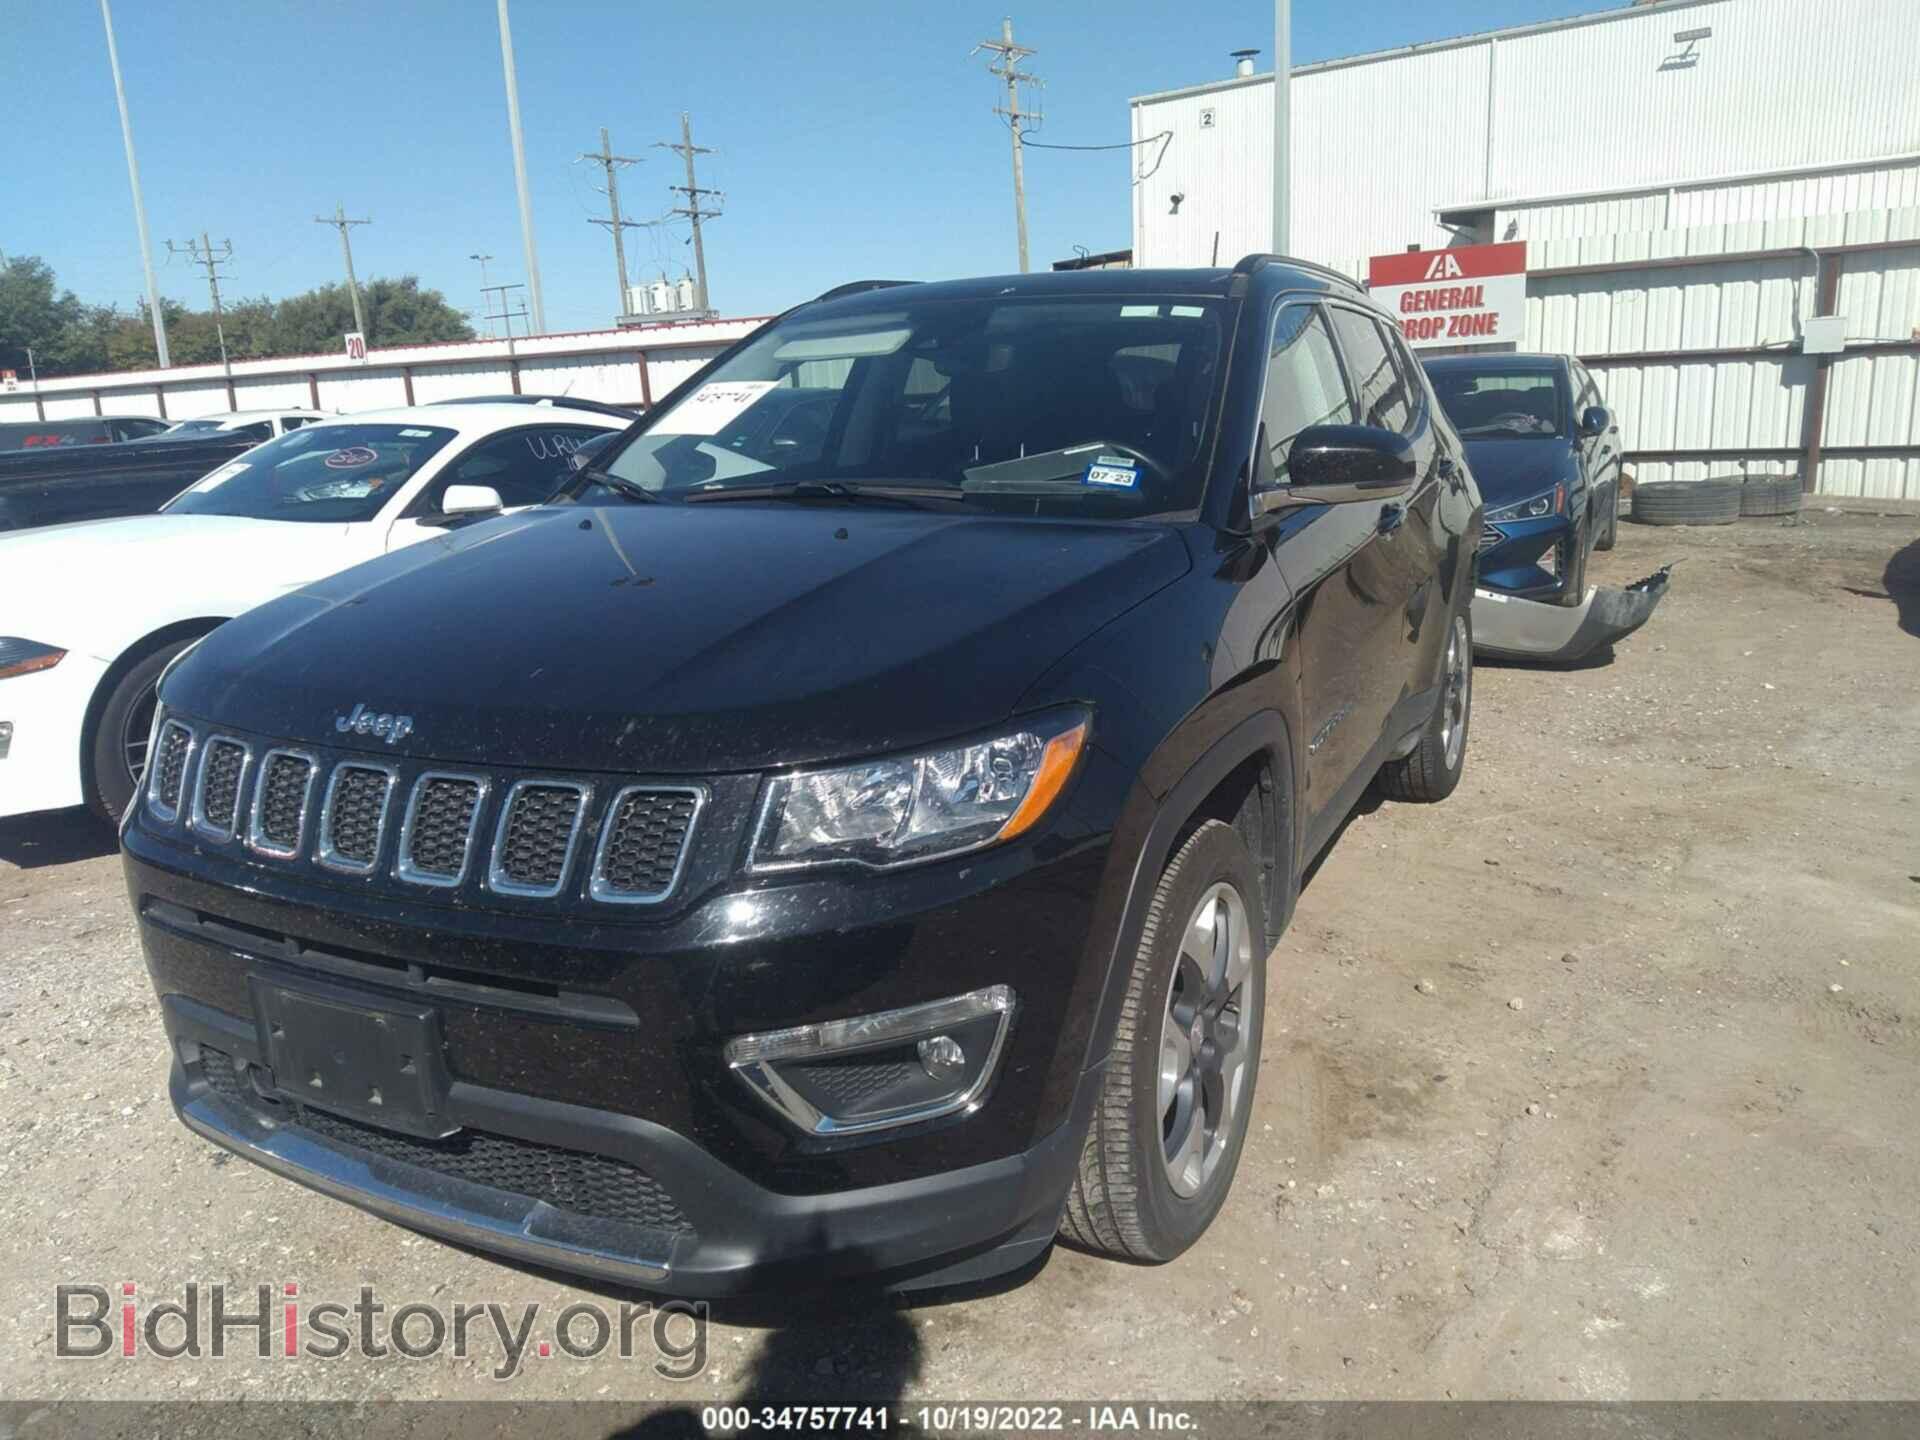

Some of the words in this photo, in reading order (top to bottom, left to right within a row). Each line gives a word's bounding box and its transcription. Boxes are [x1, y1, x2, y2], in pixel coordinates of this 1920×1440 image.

[1203, 113, 1212, 125] 2
[1400, 285, 1485, 314] GENERAL
[1446, 312, 1500, 338] ZONE
[348, 337, 364, 359] 20
[336, 703, 414, 744] Jeep
